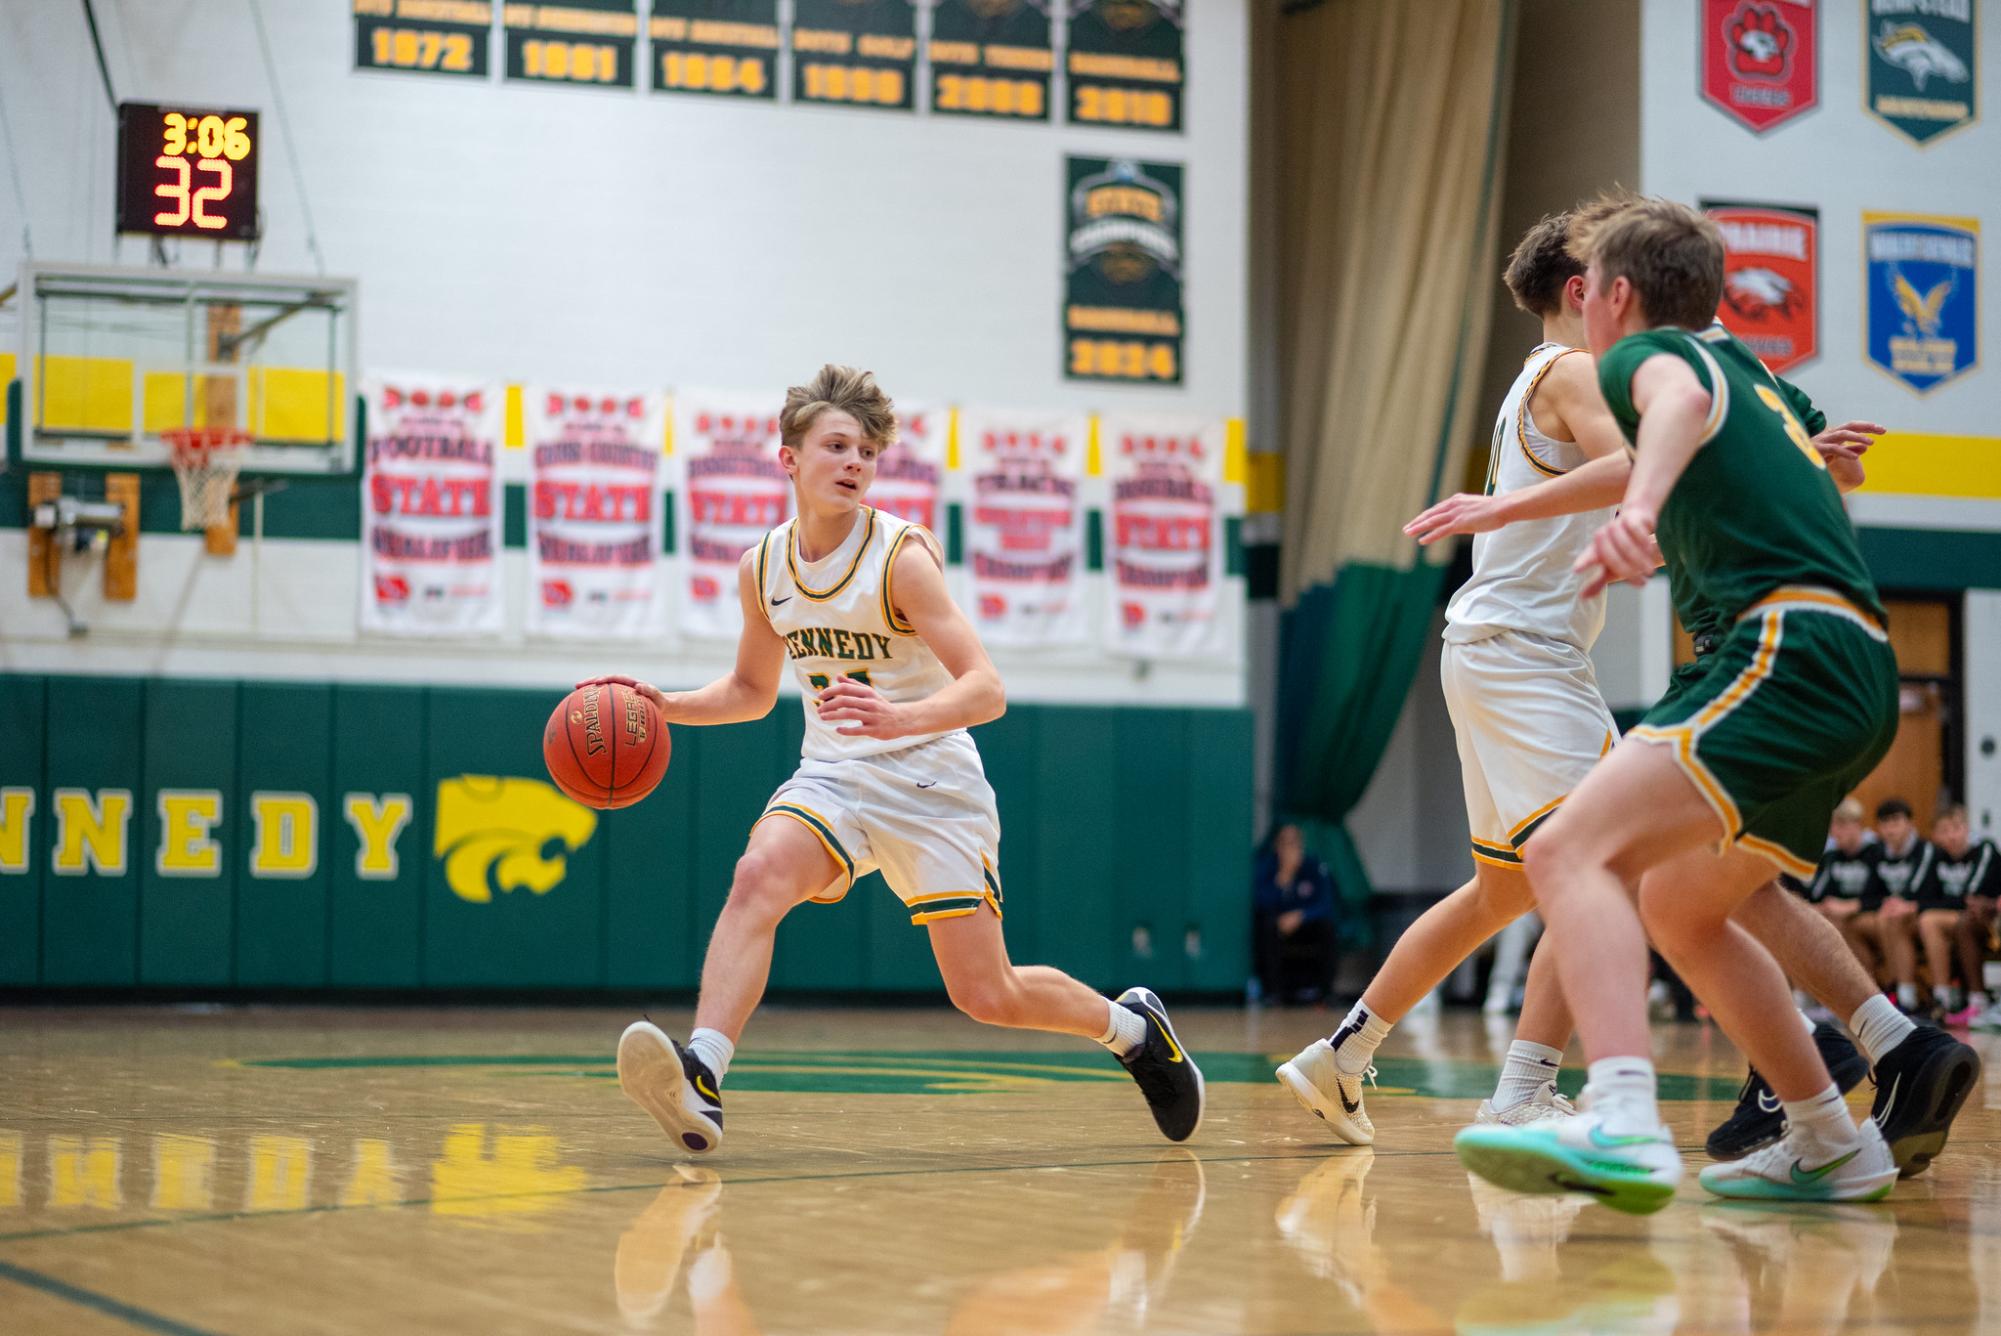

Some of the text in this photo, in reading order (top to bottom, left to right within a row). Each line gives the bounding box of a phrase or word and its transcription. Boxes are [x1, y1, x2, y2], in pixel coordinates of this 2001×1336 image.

[373, 27, 473, 71] 1972
[163, 112, 250, 160] 3:06
[154, 155, 233, 229] 32
[371, 473, 491, 517] STATE
[535, 480, 652, 522] STATE
